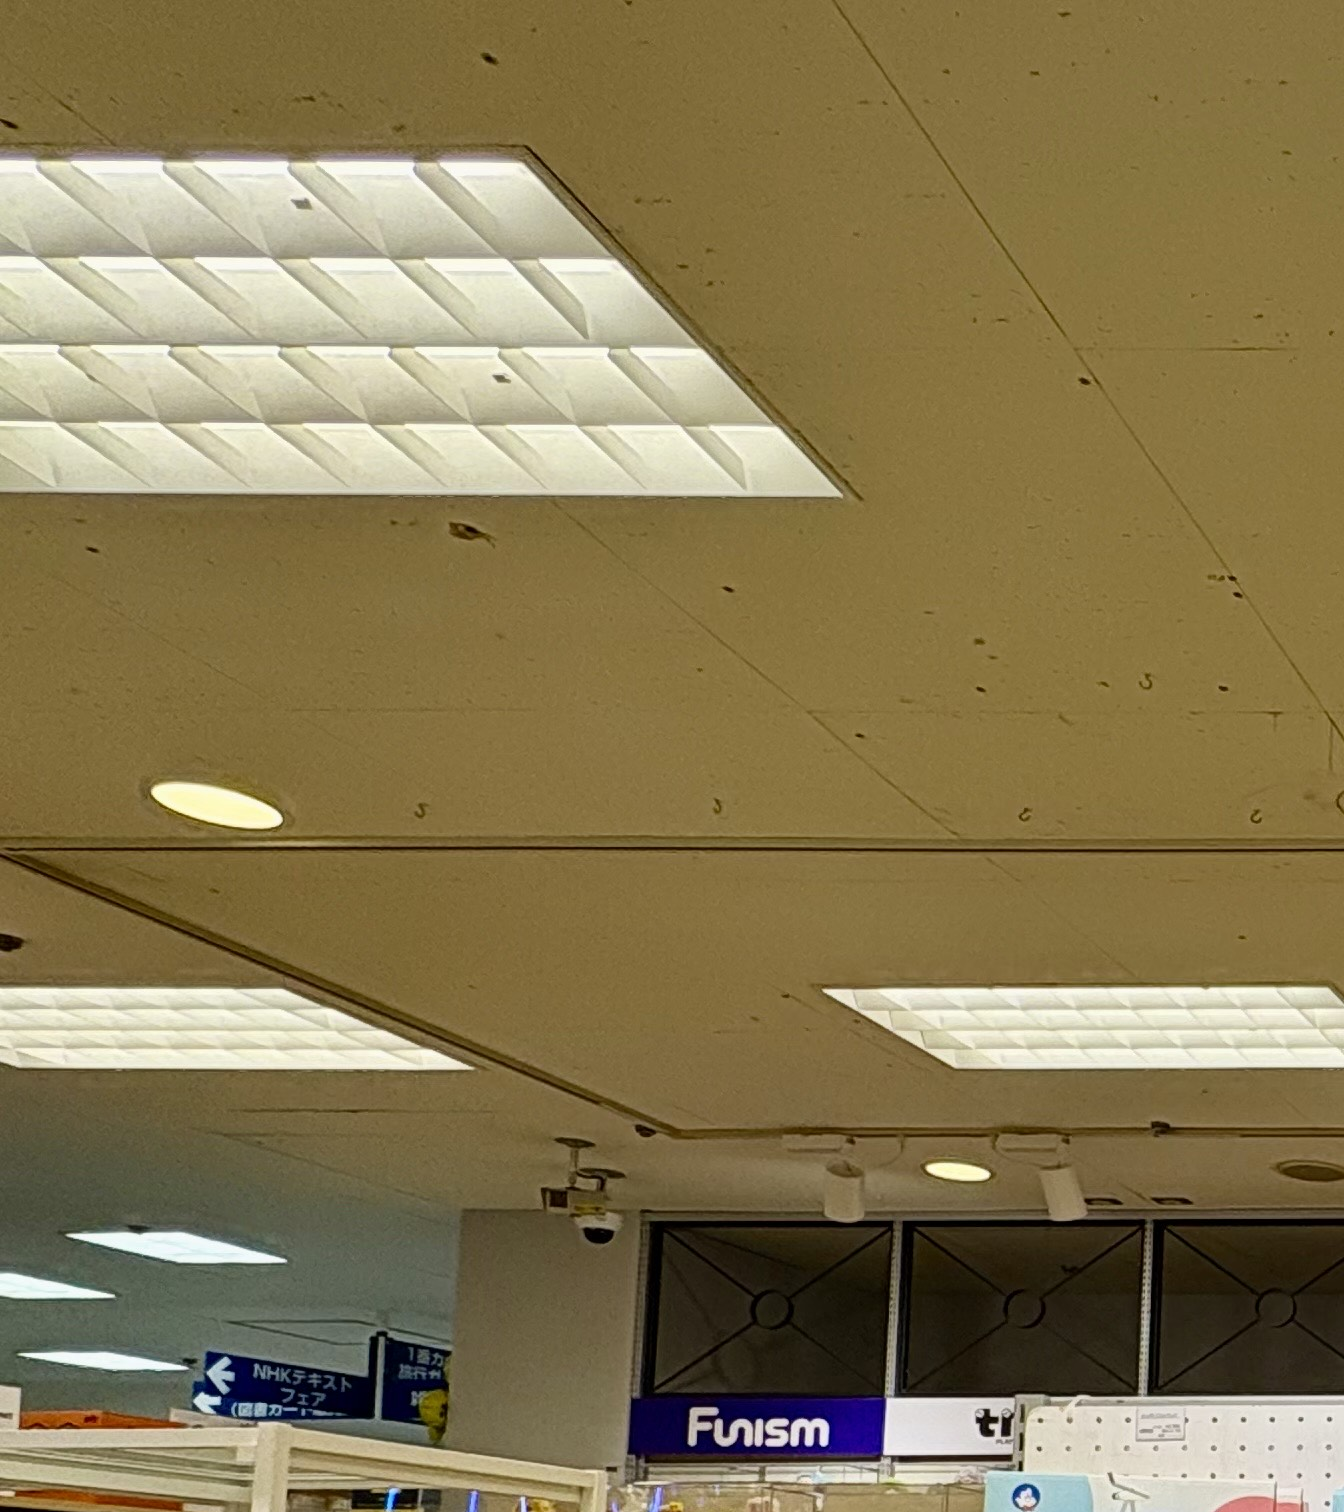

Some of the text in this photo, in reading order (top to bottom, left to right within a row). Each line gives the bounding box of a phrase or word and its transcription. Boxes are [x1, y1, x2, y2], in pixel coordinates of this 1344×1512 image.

[253, 1363, 352, 1392] NHKテキスト
[280, 1387, 327, 1406] フェア
